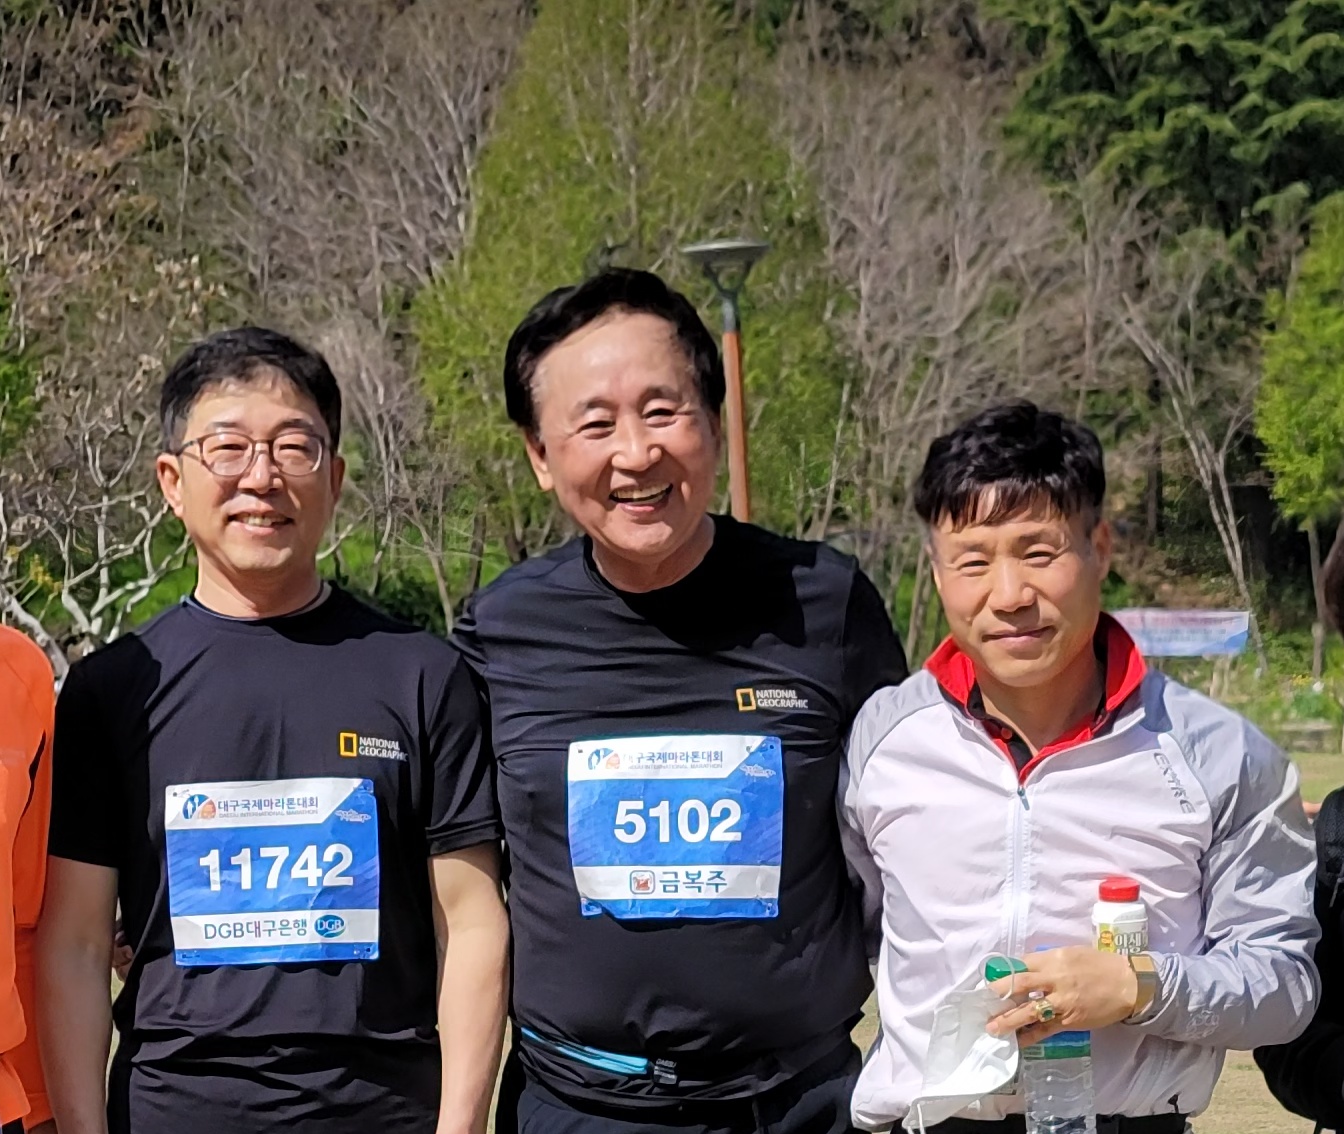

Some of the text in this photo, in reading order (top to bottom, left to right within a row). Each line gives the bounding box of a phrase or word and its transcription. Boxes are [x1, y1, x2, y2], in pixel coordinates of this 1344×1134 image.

[756, 689, 798, 699] NATIONAL
[757, 698, 809, 709] GEOGRAPHIC
[359, 736, 400, 751] NATIONAL
[358, 746, 409, 762] GEOGRAPHIC
[217, 796, 319, 812] 대구국제마라톤대회
[613, 799, 742, 844] 5102
[199, 843, 354, 891] 11742
[659, 870, 728, 893] 금복주
[317, 919, 343, 931] DGB
